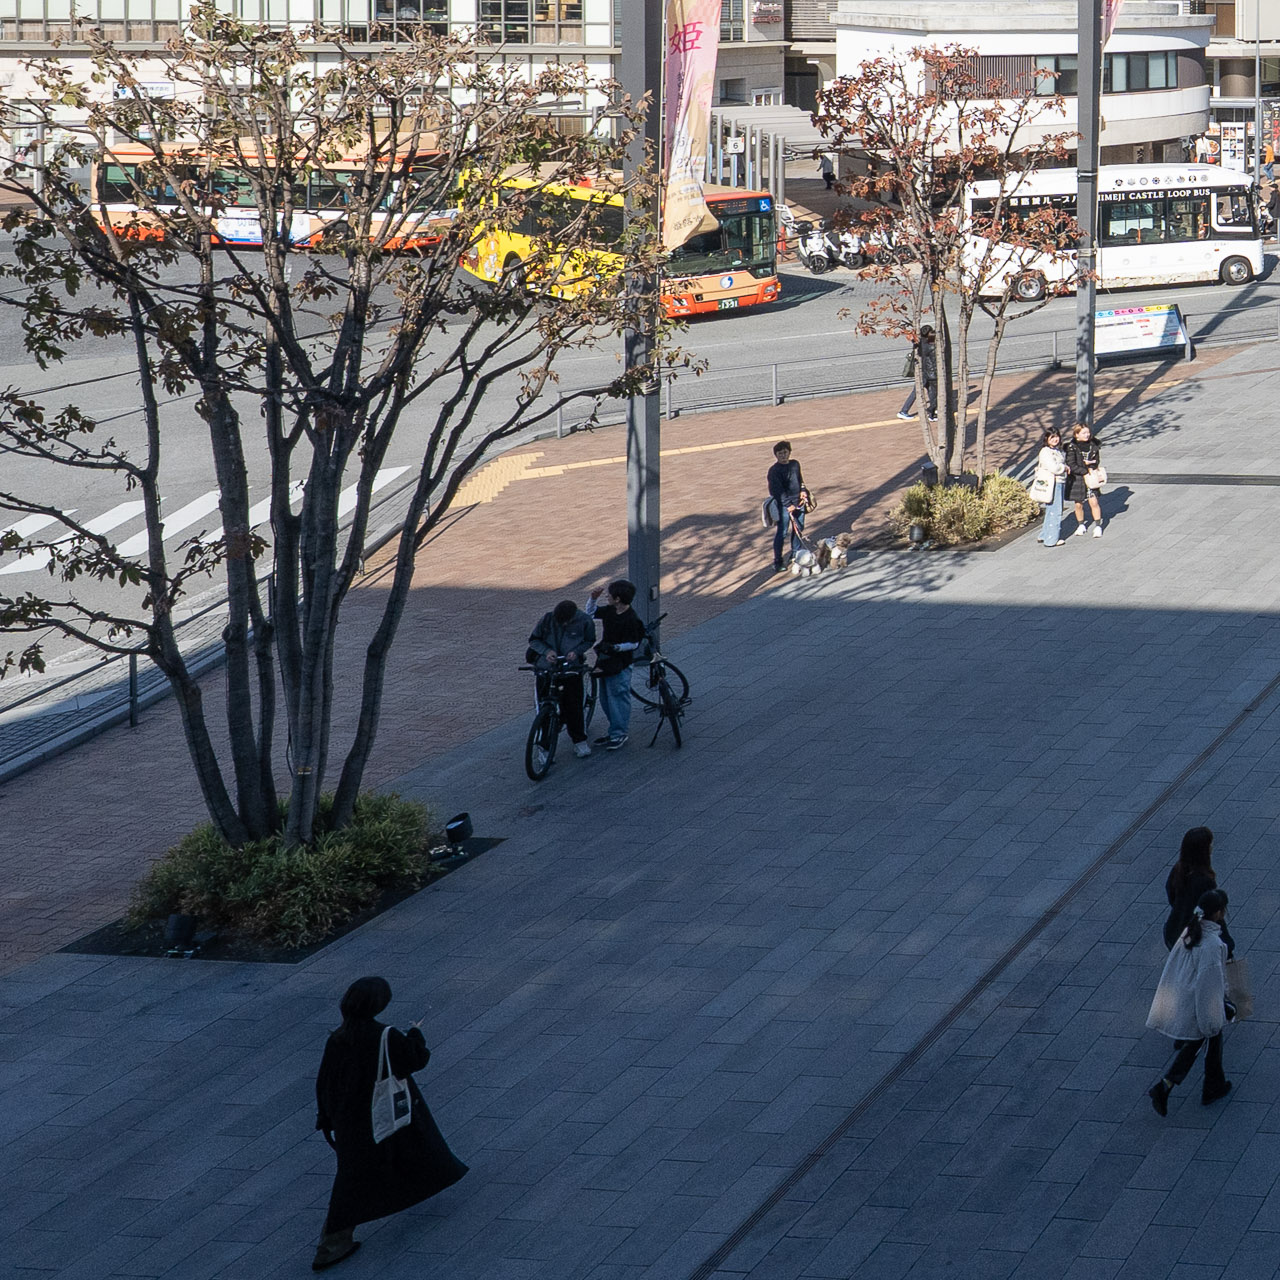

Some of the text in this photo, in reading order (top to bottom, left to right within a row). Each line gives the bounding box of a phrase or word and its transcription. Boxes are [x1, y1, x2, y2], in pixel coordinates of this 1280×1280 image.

[1128, 190, 1164, 201] CASTLE
[1167, 189, 1192, 199] LOOP
[1193, 188, 1212, 198] BUS
